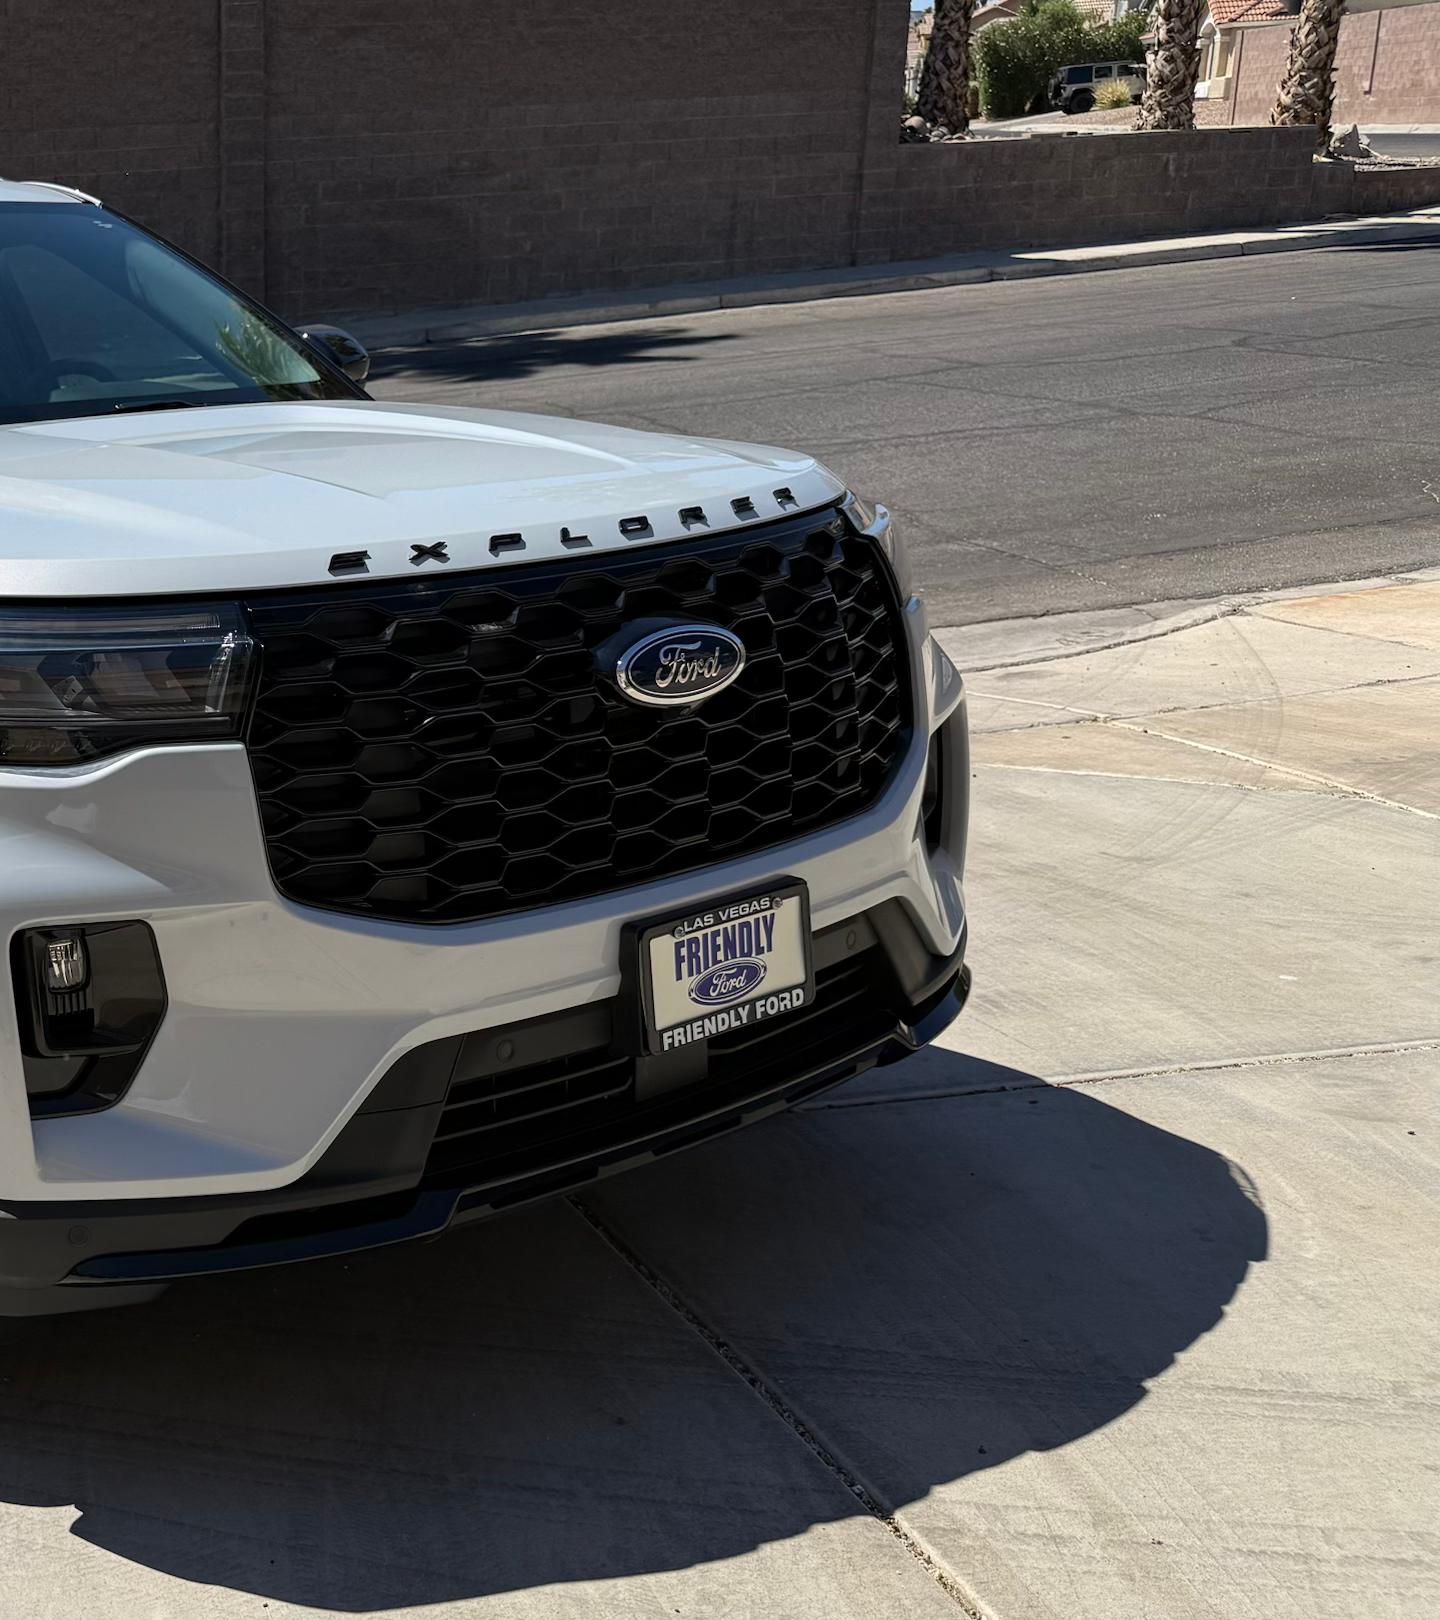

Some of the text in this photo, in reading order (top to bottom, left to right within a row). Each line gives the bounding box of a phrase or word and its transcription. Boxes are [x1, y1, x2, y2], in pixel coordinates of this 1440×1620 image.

[328, 487, 797, 575] EXPLORER
[655, 641, 722, 688] Ford
[683, 897, 771, 932] LAS VEGAS
[673, 912, 776, 982] FRIENDLY
[709, 967, 748, 997] Ford
[662, 988, 805, 1052] FRIENDLY FORD
